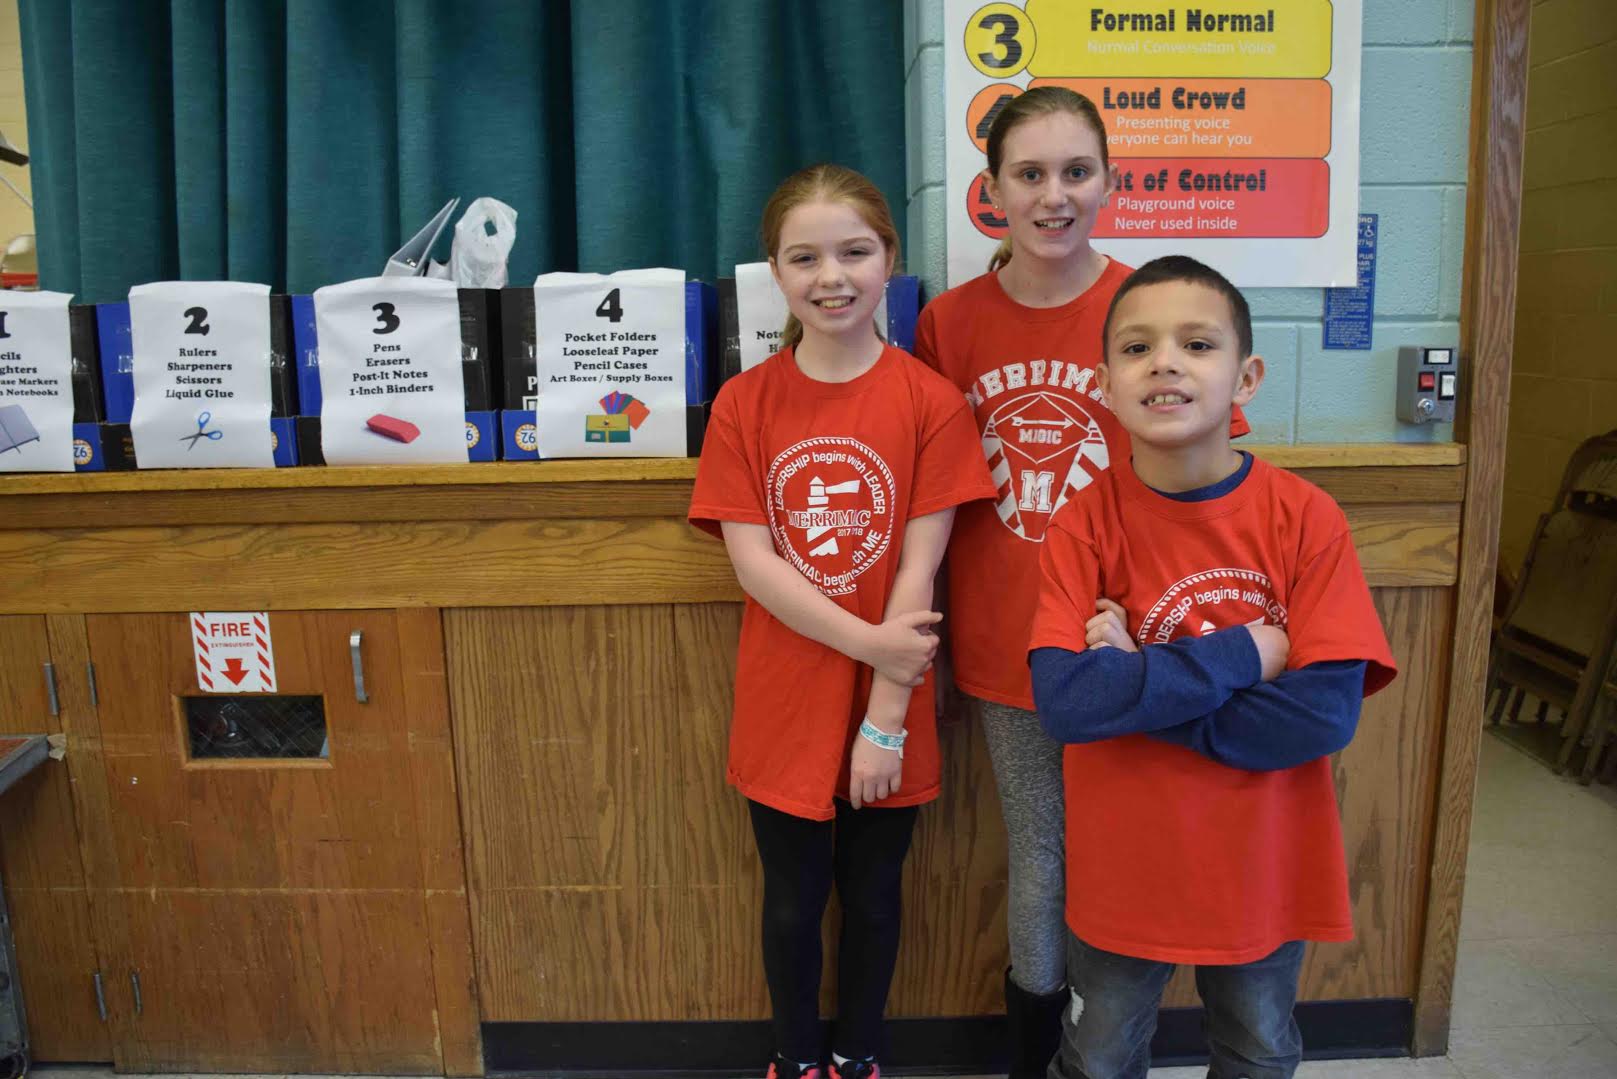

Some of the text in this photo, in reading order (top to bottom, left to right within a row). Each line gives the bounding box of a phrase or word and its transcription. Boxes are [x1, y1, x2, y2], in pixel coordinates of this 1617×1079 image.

[1090, 8, 1275, 32] Formal Normal
[978, 13, 1022, 69] 3
[1103, 87, 1246, 110] Loud Crowd
[1116, 116, 1231, 132] Presenting voice
[1105, 132, 1252, 148] veryone can hear you
[1143, 169, 1168, 192] of
[1178, 168, 1266, 192] Control
[1118, 197, 1236, 213] Playground voice
[1115, 217, 1238, 230] Never used inside
[595, 288, 624, 323] 4
[183, 306, 210, 336] 2
[372, 302, 400, 334] 3
[564, 332, 657, 343] Pocket Folders
[178, 348, 217, 357] Rulers
[373, 344, 401, 353] Pens
[563, 346, 659, 357] Looseleaf Paper
[0, 352, 22, 361] cils
[366, 357, 411, 368] Erasers
[0, 366, 38, 376] ghters
[167, 362, 232, 372] Sharpeners
[574, 360, 648, 370] Pencil Cases
[18, 378, 58, 386] Markers
[176, 375, 222, 384] Scissors
[352, 370, 428, 382] Post-It Notes
[550, 375, 567, 383] Art
[570, 375, 597, 383] Boxes
[606, 374, 642, 384] Supply
[644, 374, 673, 382] Boxes
[6, 388, 58, 397] Notebooks
[165, 389, 234, 400] Liquid Glue
[349, 384, 434, 396] 1-Inch Binders
[776, 450, 886, 515] LEADERSHIP begins with LEADER
[1018, 470, 1055, 514] M
[824, 570, 855, 588] begin
[861, 529, 882, 552] ME
[1194, 585, 1240, 605] begins
[1242, 589, 1267, 609] with
[210, 622, 251, 638] FIRE
